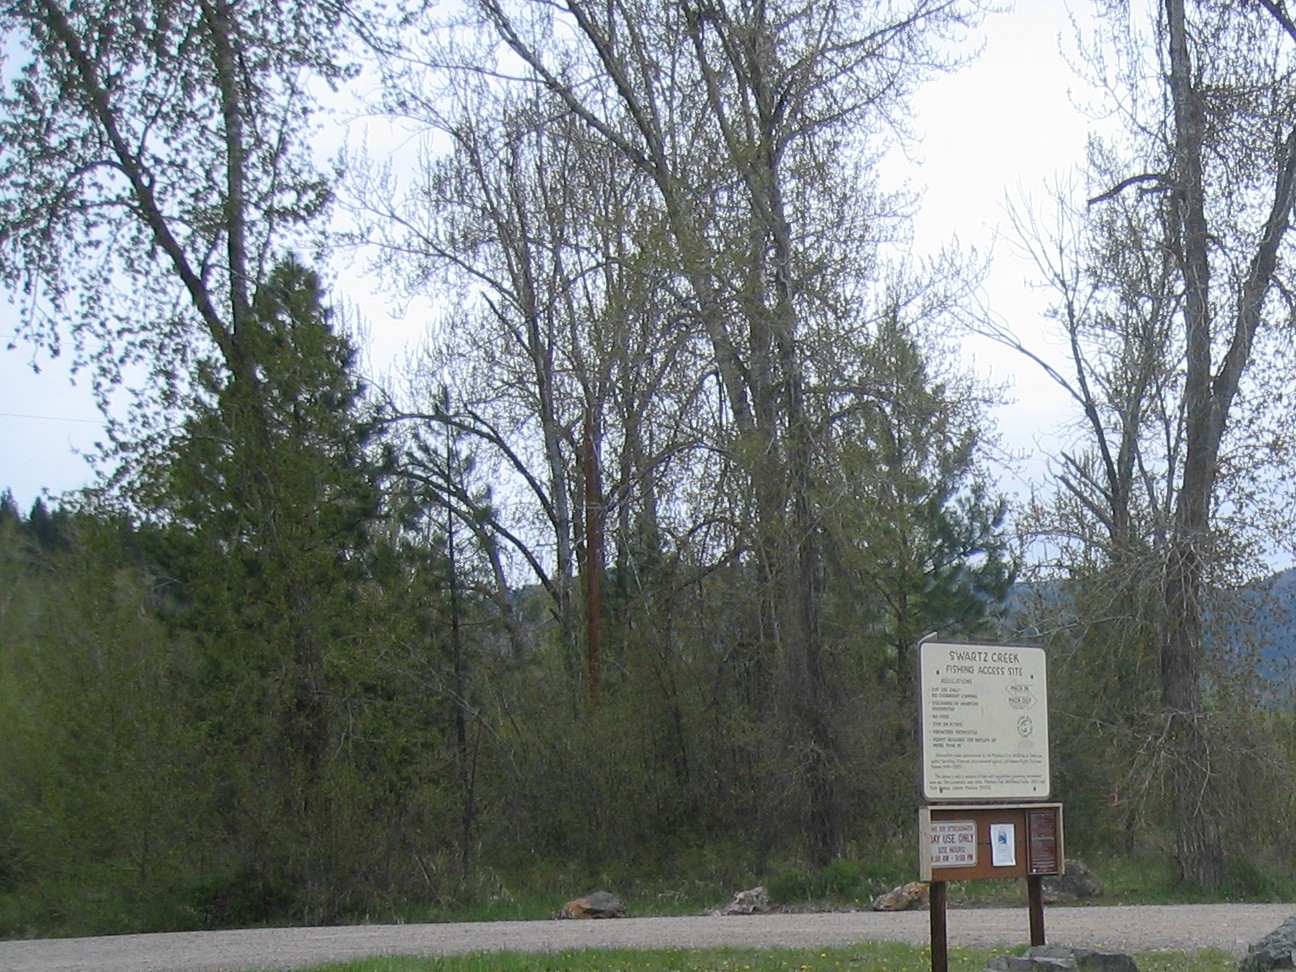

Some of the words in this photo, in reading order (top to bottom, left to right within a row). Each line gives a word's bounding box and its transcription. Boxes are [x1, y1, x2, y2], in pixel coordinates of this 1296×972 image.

[991, 652, 1020, 664] CREEK
[946, 664, 974, 674] FISHING
[977, 666, 1005, 676] ACCESS
[1007, 667, 1023, 677] SITE
[942, 833, 955, 844] USE
[958, 832, 974, 843] ONLY
